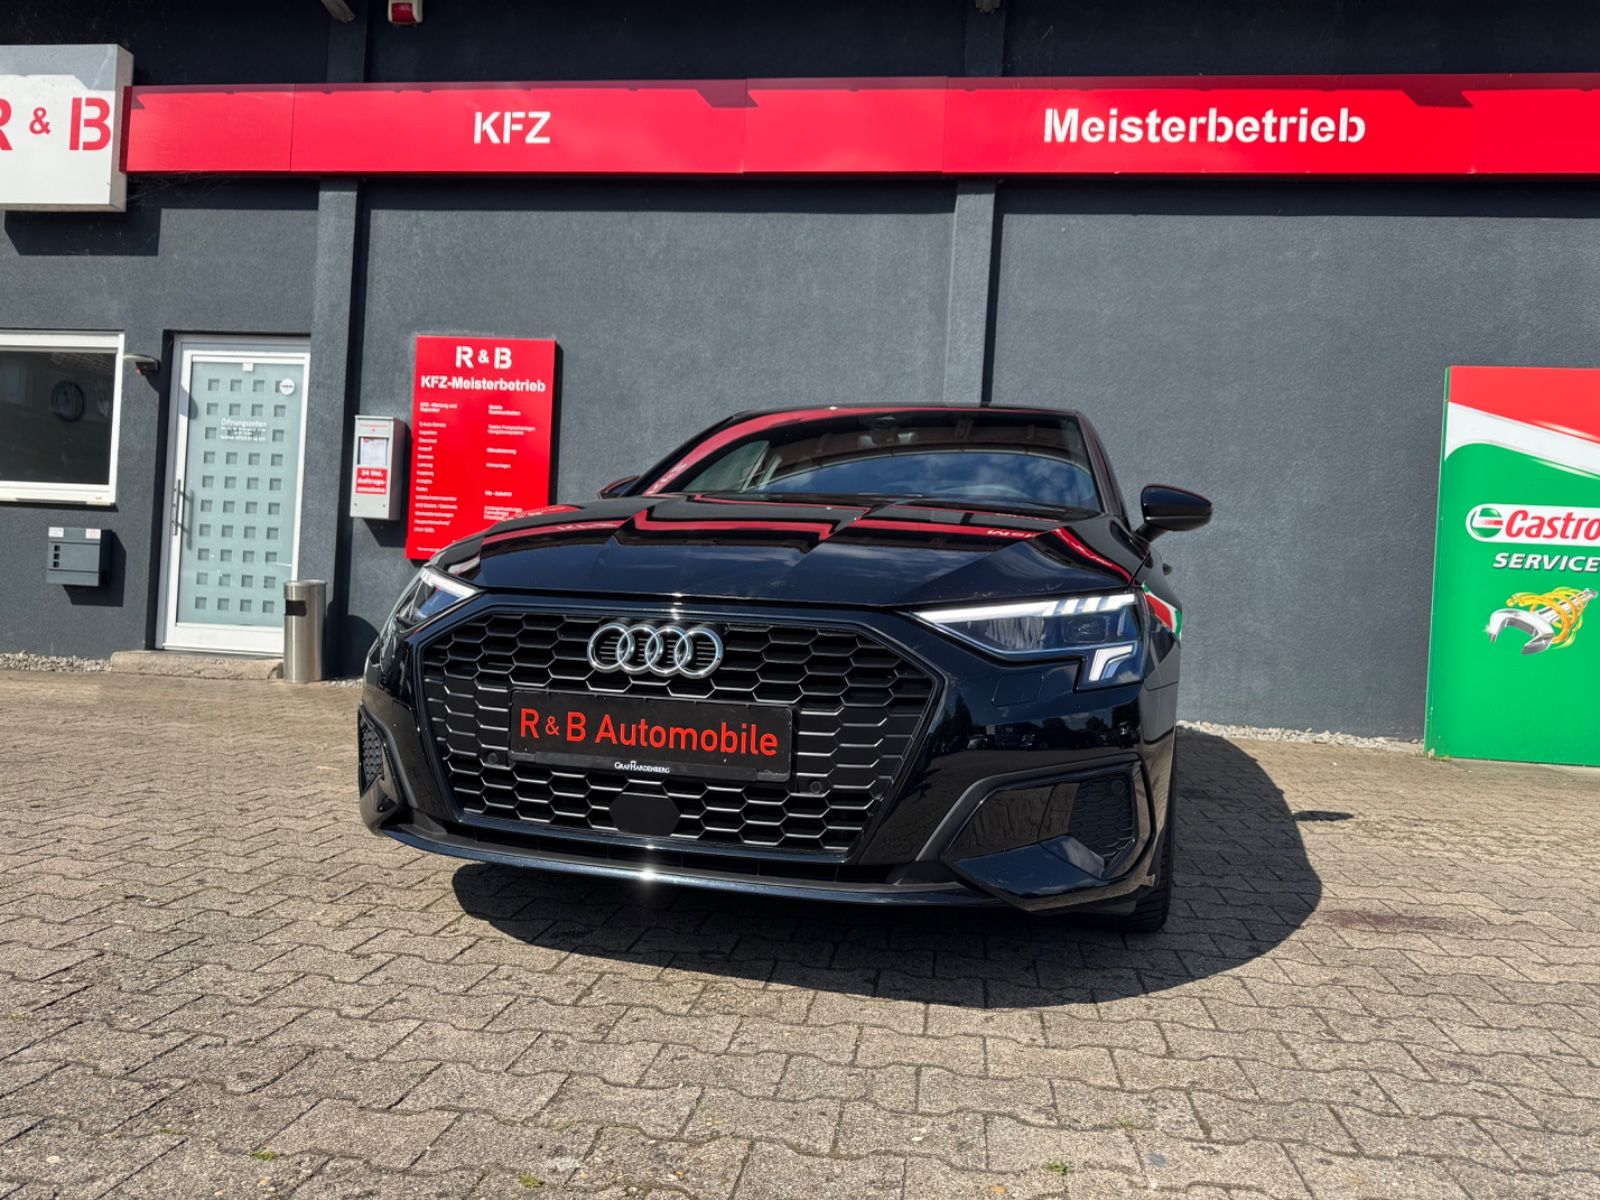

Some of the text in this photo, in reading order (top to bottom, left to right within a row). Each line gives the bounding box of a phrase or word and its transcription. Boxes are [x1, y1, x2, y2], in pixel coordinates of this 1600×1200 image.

[29, 106, 51, 135] &
[69, 97, 111, 150] B
[474, 107, 1366, 144] KFZ Meisterbetrieb
[455, 346, 512, 369] R & B
[420, 375, 546, 392] KFZ-Meisterbetrieb
[1492, 552, 1600, 573] SERVICE
[520, 708, 778, 757] R & B Automobile
